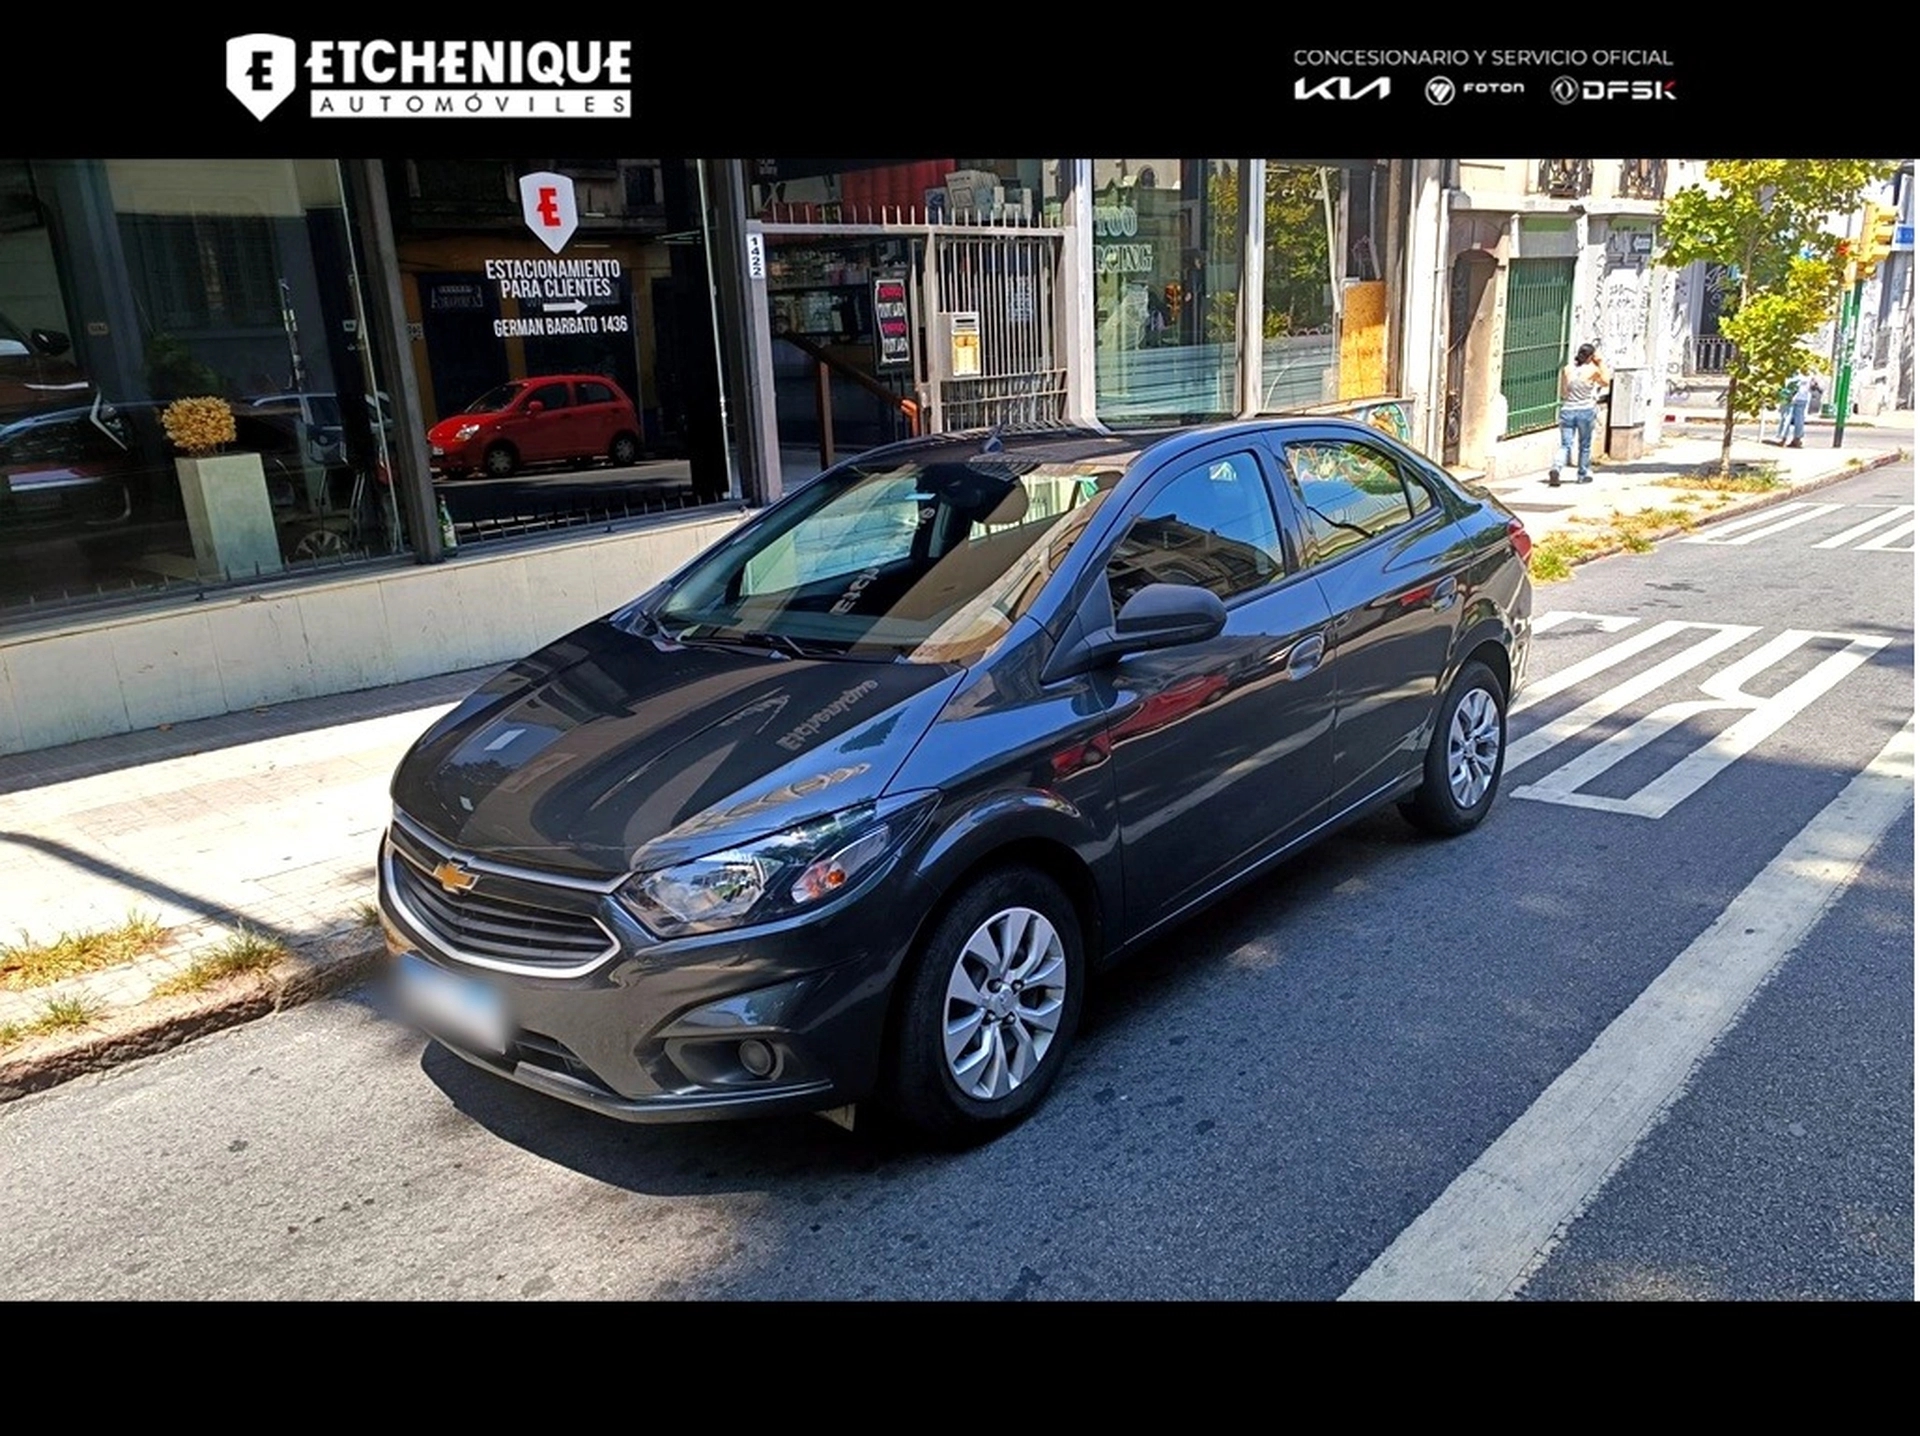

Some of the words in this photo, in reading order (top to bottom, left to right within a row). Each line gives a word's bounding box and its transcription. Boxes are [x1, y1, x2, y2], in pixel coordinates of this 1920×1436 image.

[750, 236, 762, 276] 1422
[485, 259, 621, 279] ESTACIONAMIENTO
[501, 279, 543, 299] PARA
[544, 277, 612, 298] CLIENTES
[493, 319, 545, 337] GERMAN
[545, 315, 598, 335] BARBATO
[600, 315, 629, 333] 1436
